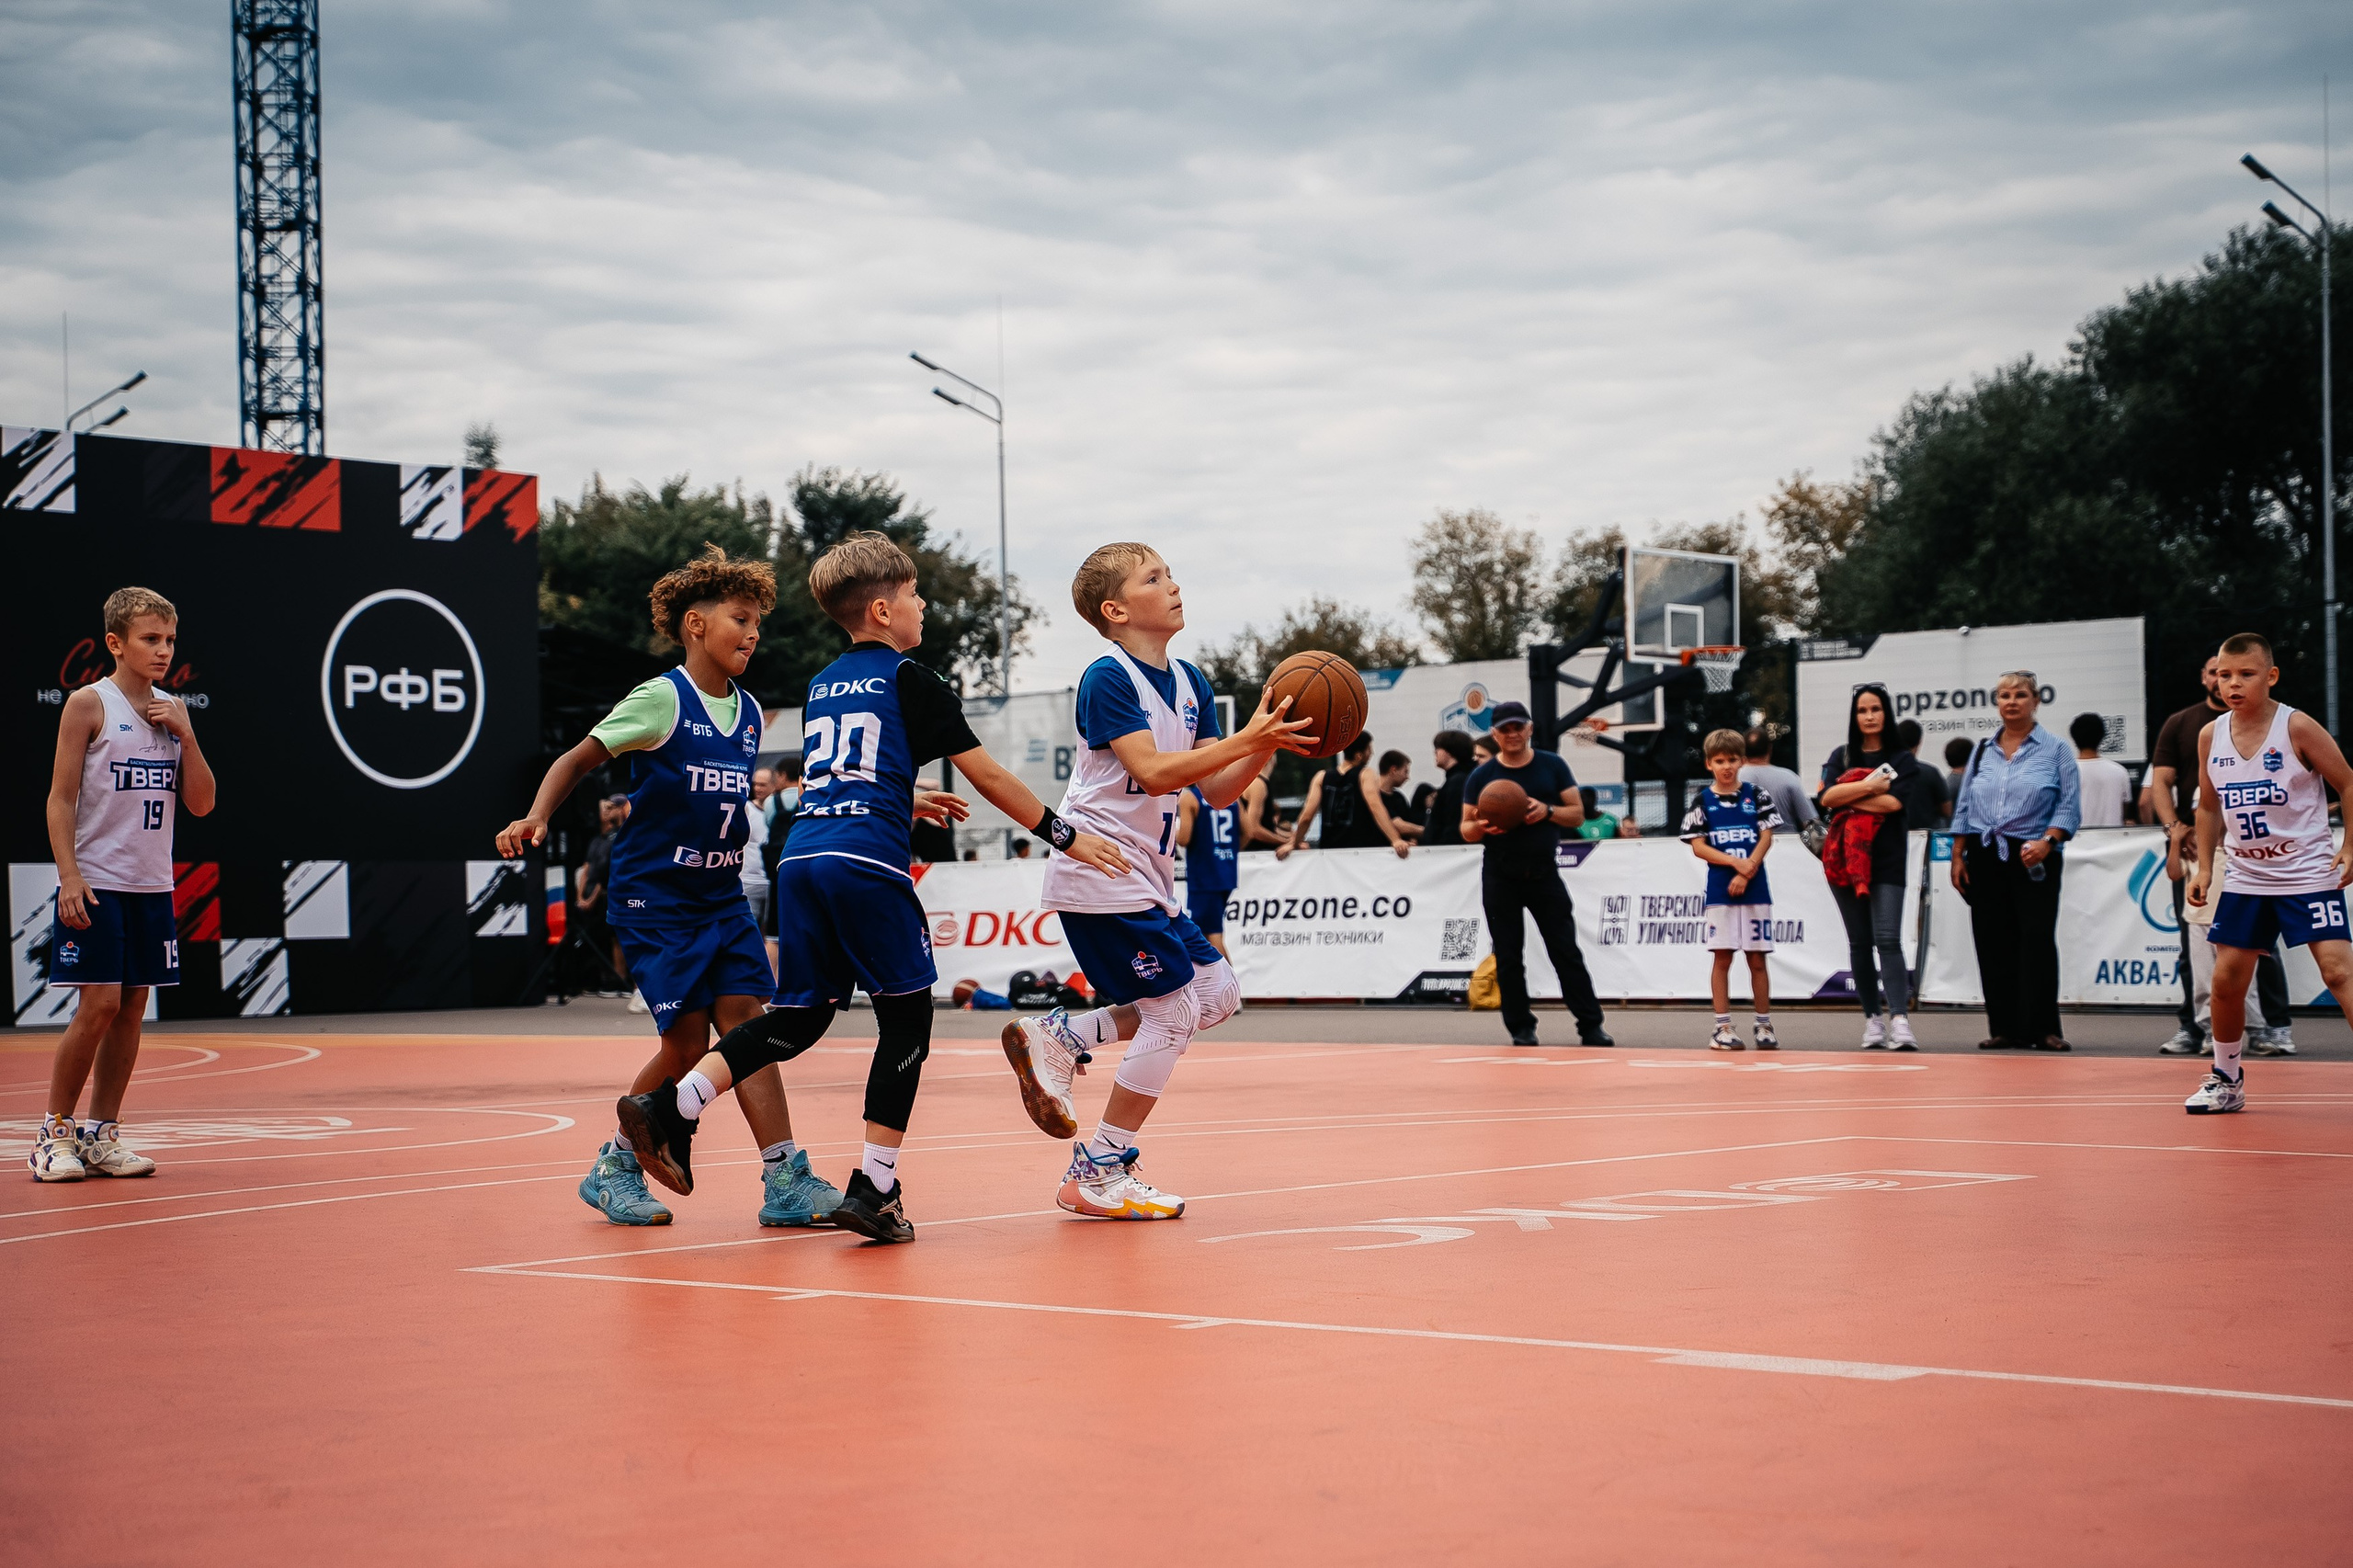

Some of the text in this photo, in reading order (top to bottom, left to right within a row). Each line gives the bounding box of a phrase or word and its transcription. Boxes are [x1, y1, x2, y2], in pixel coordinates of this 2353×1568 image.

[344, 665, 466, 712] РФБ
[829, 677, 886, 698] DKC
[692, 722, 713, 737] ВТБ
[801, 711, 881, 791] 20
[2219, 756, 2235, 767] ВТБ
[2218, 786, 2286, 807] ТВЕРЬ
[142, 800, 165, 830] 19
[719, 802, 736, 839] 7
[1209, 808, 1233, 844] 12
[2235, 811, 2271, 840] 36
[627, 899, 646, 908] STK
[1225, 894, 1412, 926] appzone.co
[2308, 900, 2345, 930] 36
[964, 910, 1063, 947] DKC
[1241, 929, 1384, 947] магазин техники
[1136, 967, 1164, 979] ТВЕРЬ
